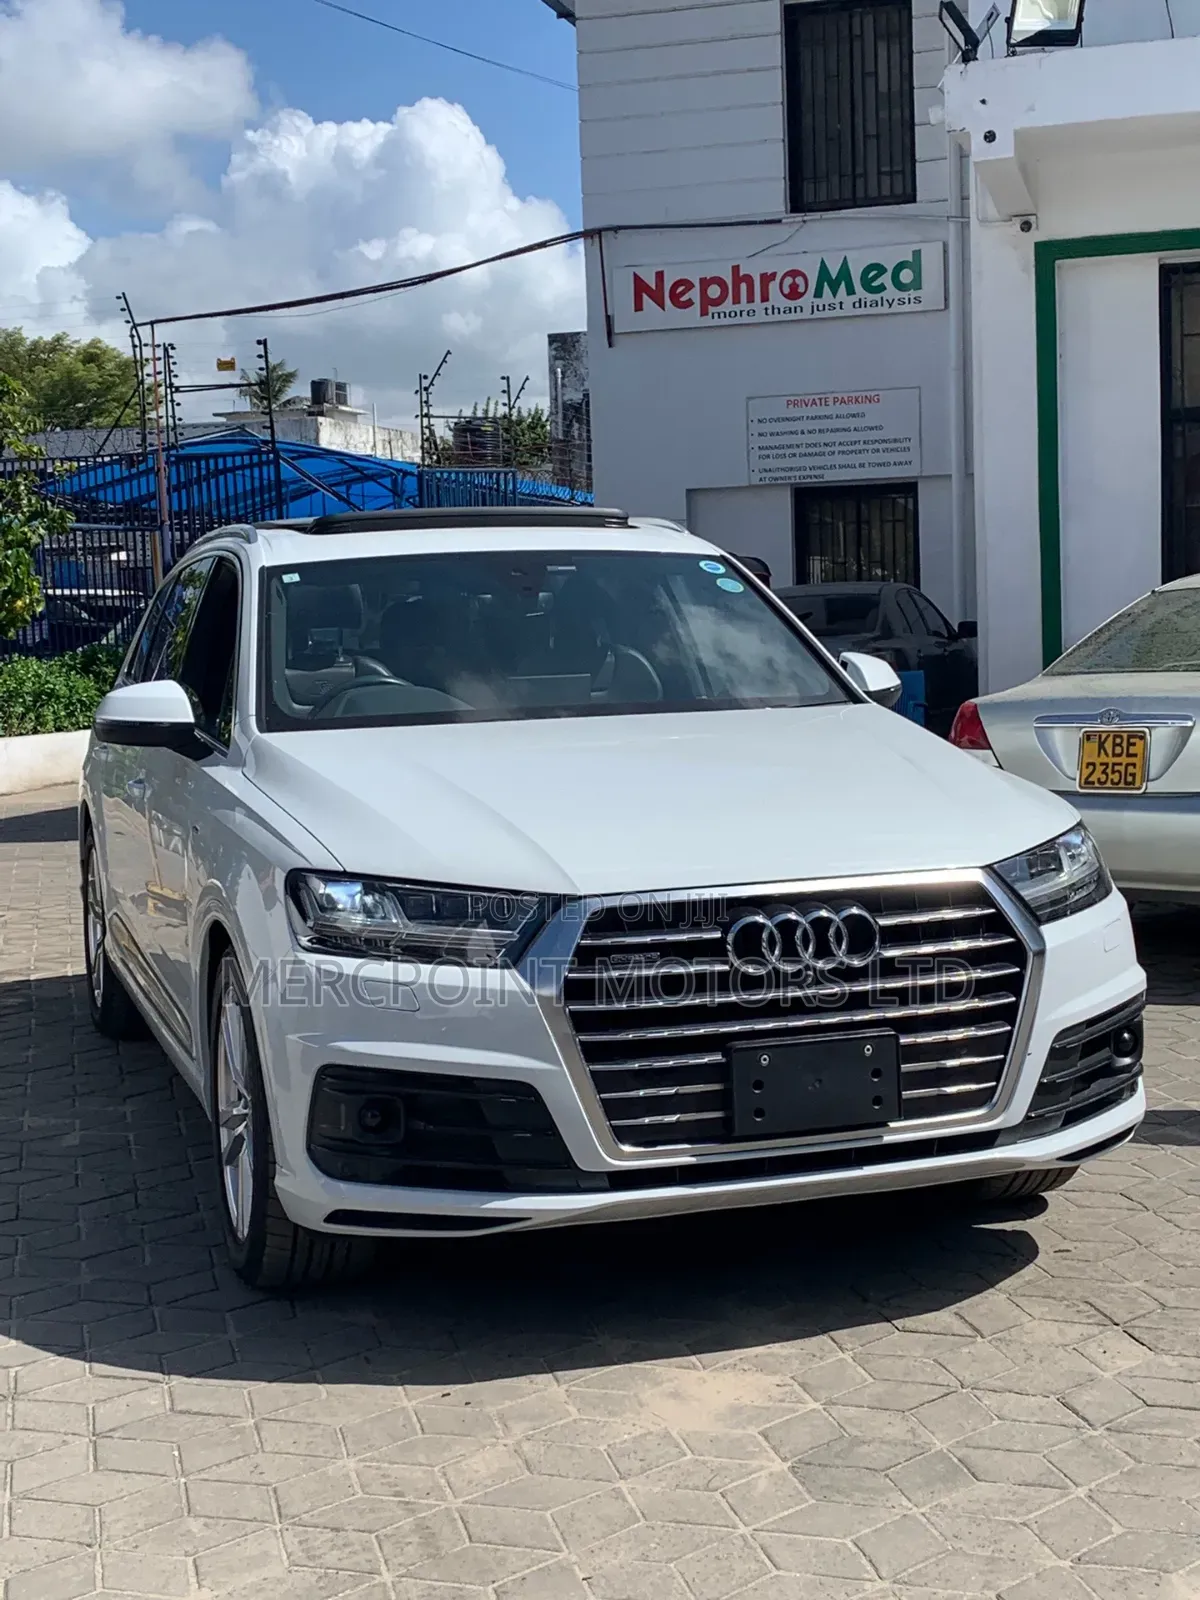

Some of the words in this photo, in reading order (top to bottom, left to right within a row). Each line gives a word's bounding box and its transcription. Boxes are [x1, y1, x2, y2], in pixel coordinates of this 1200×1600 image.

[710, 309, 756, 320] more
[763, 304, 804, 316] than
[810, 301, 844, 315] just
[852, 294, 922, 311] dialysis
[786, 397, 830, 408] PRIVATE
[832, 394, 880, 405] PARKING
[769, 429, 799, 437] WASHING
[758, 443, 804, 451] MANAGEMENT
[862, 437, 912, 445] RESPONSIBILITY
[838, 448, 869, 456] PROPERTY
[808, 463, 837, 471] VEHICLES
[868, 460, 891, 468] TOWED
[1097, 734, 1138, 758] KBE
[1083, 762, 1137, 786] 235G
